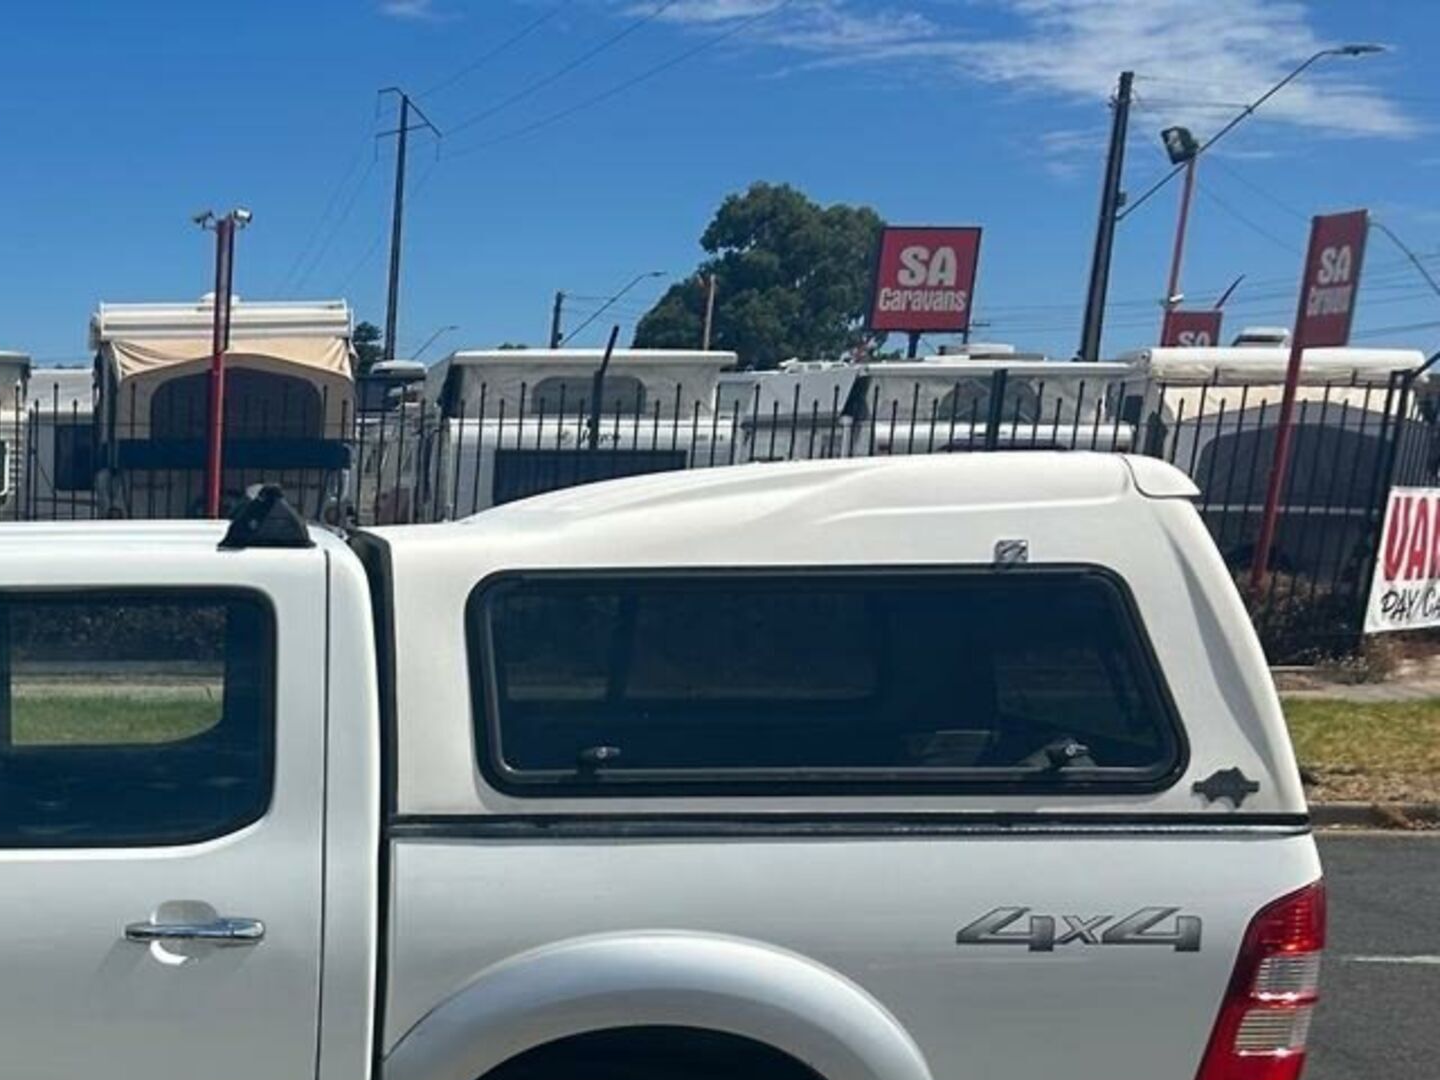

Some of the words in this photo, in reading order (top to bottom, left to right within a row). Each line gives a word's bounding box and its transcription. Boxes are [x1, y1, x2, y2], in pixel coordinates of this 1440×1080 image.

[897, 245, 957, 287] SA
[1317, 245, 1351, 285] SA
[879, 287, 967, 312] Caravans
[955, 906, 1202, 952] 4x4
